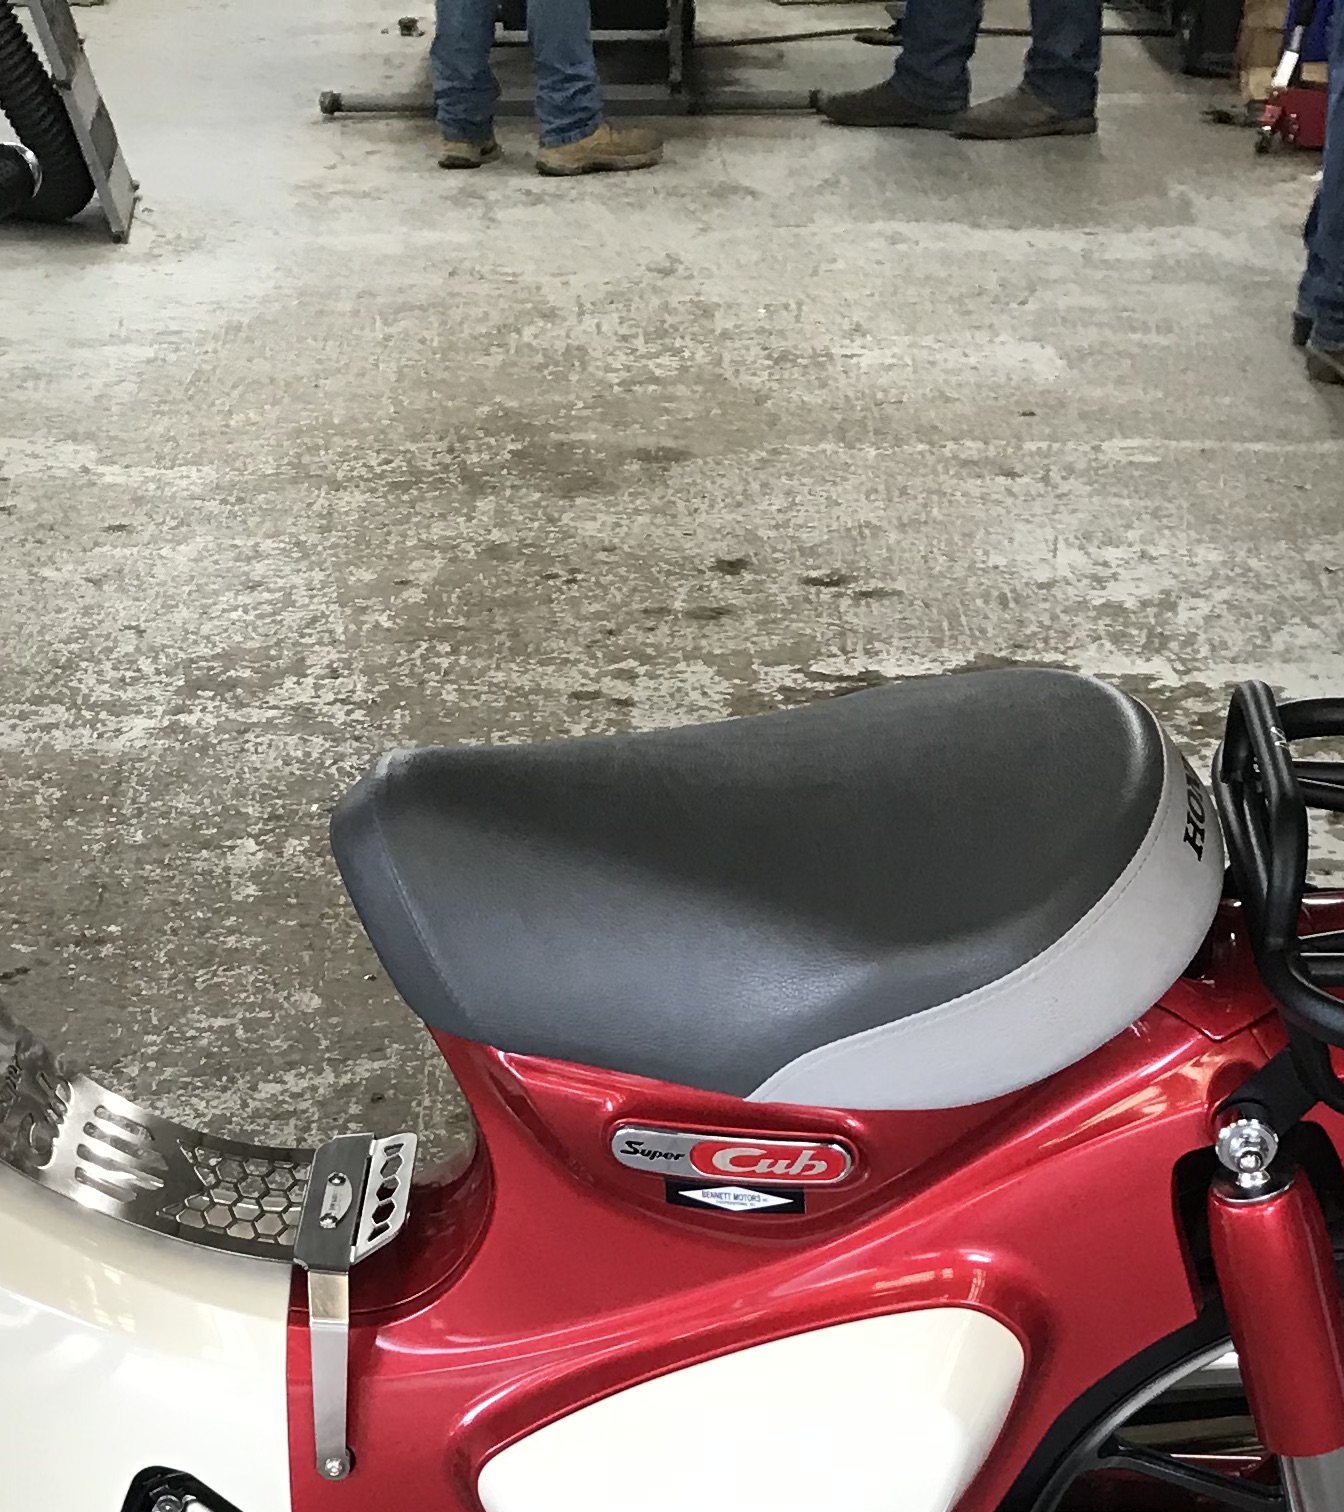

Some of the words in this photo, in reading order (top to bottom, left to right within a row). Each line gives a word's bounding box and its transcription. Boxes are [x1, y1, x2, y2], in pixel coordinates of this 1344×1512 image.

[1182, 755, 1206, 862] HON
[620, 1140, 686, 1161] Super
[712, 1147, 828, 1176] Cub
[733, 1193, 761, 1203] MOTORS
